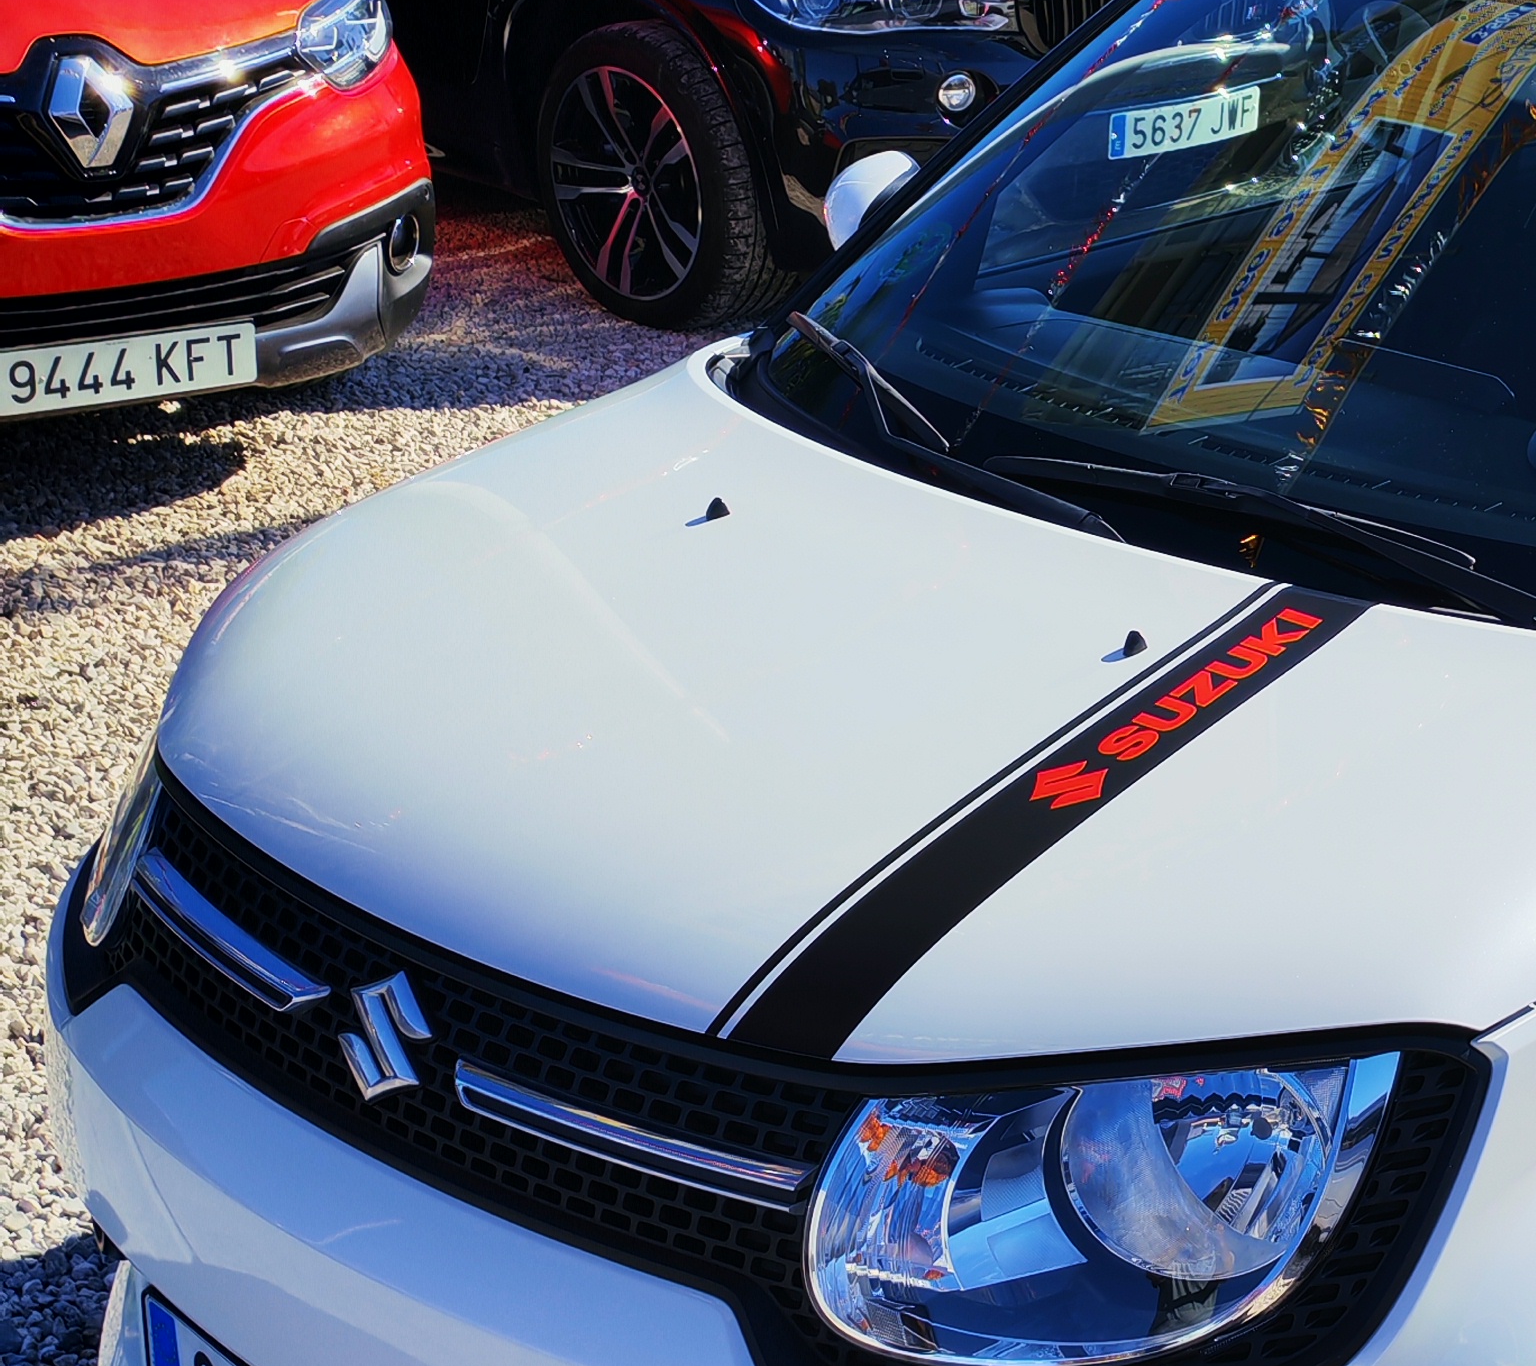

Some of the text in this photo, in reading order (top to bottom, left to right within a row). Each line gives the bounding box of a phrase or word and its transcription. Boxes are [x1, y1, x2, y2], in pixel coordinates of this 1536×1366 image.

[1131, 94, 1253, 150] 5637 JWF
[9, 333, 242, 405] 9444 KFT
[1097, 606, 1325, 761] SUZUKI
